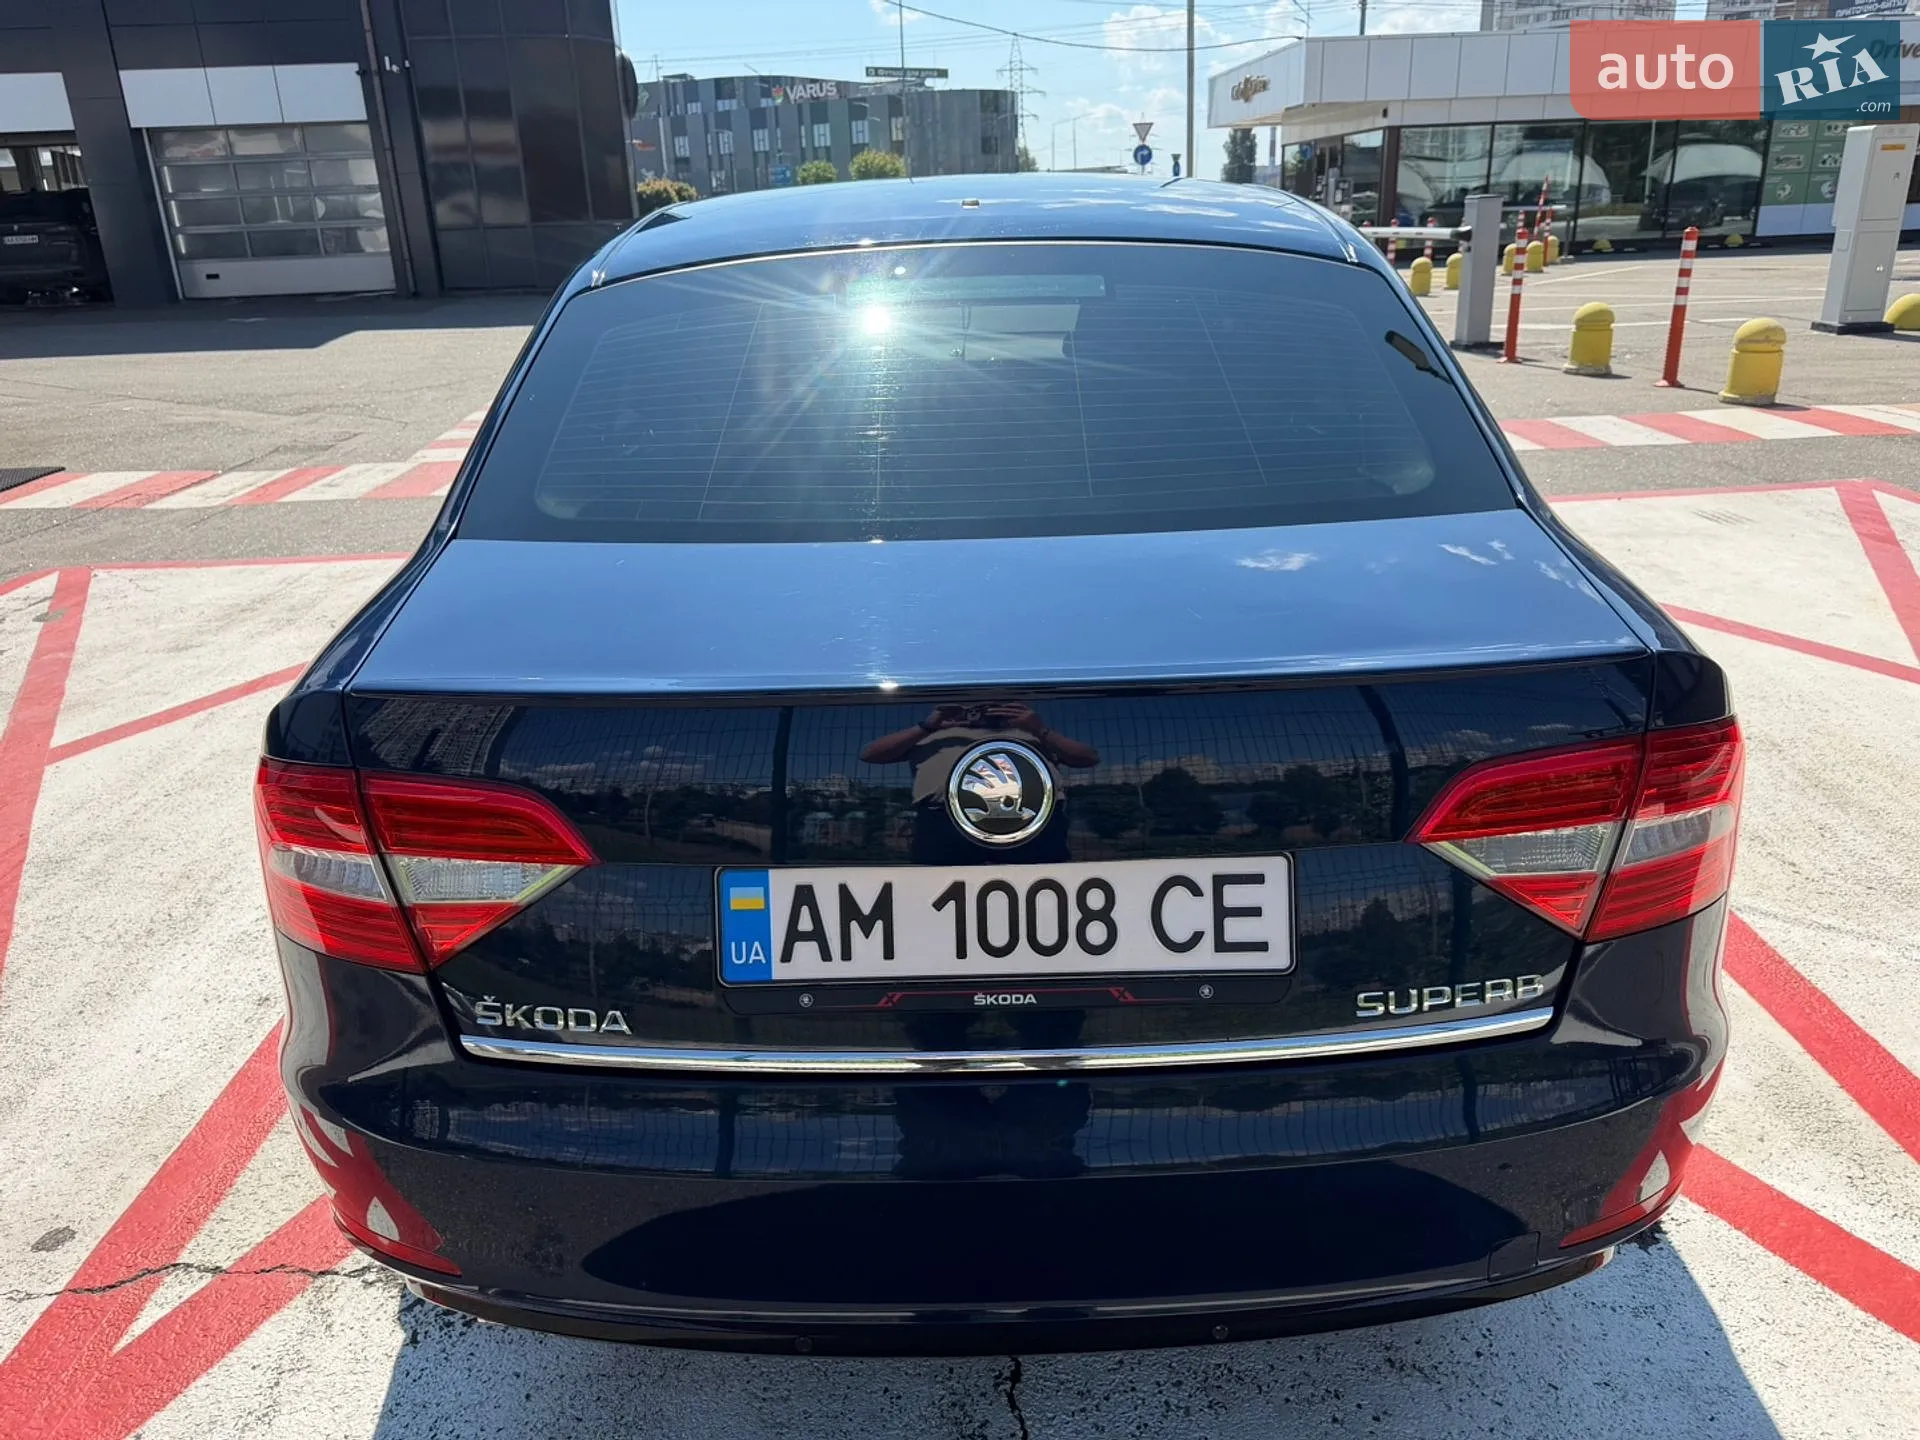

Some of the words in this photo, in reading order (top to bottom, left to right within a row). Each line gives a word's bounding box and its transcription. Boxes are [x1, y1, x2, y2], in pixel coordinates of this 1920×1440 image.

[785, 82, 838, 104] VARUS
[779, 882, 895, 964] AM
[931, 877, 1119, 961] 1008
[1150, 873, 1270, 955] CE
[731, 941, 766, 965] UA
[973, 992, 1037, 1006] ŠKODA
[1356, 974, 1545, 1018] SUPERB
[474, 995, 633, 1036] ŠKODA
